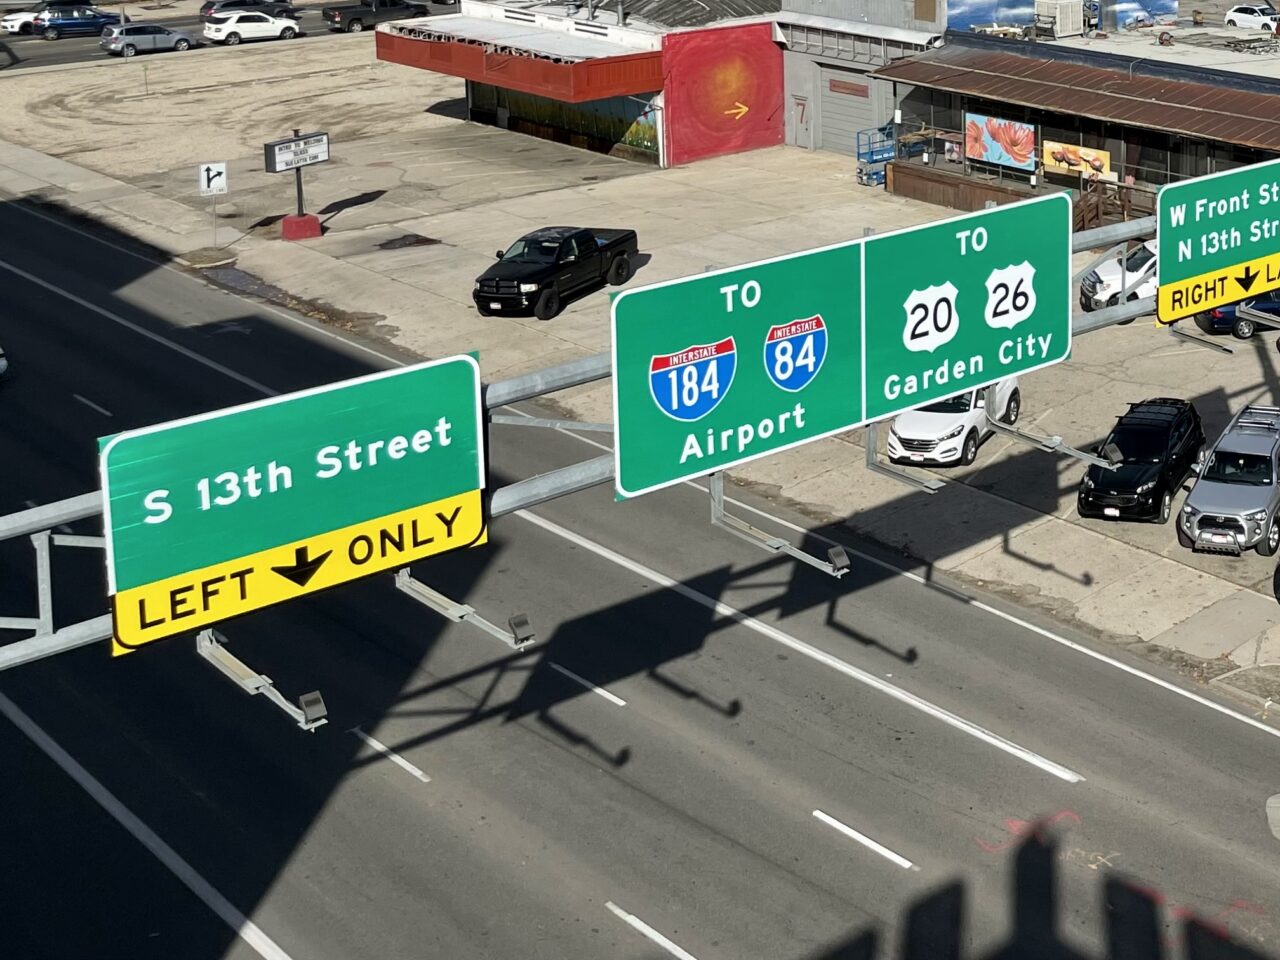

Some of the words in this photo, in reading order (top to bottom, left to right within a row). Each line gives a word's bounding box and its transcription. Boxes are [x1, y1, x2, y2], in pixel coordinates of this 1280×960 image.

[1169, 201, 1187, 228] W
[1195, 189, 1250, 222] Front
[956, 226, 988, 256] TO
[1178, 239, 1192, 262] N
[1200, 226, 1241, 256] 13th
[720, 279, 762, 313] TO
[991, 275, 1030, 319] 26
[1171, 276, 1229, 312] RIGHT
[773, 319, 818, 340] INTERSTATE
[909, 294, 954, 341] 20
[669, 345, 717, 366] INTERSTATE
[774, 334, 817, 381] 84
[884, 352, 985, 401] Garden
[998, 331, 1054, 367] City
[667, 359, 720, 411] 184
[679, 402, 807, 466] Airport
[143, 489, 173, 526] S
[196, 460, 293, 512] 13th
[315, 415, 453, 480] Street
[137, 568, 256, 631] LEFT
[347, 506, 464, 567] ONLY
